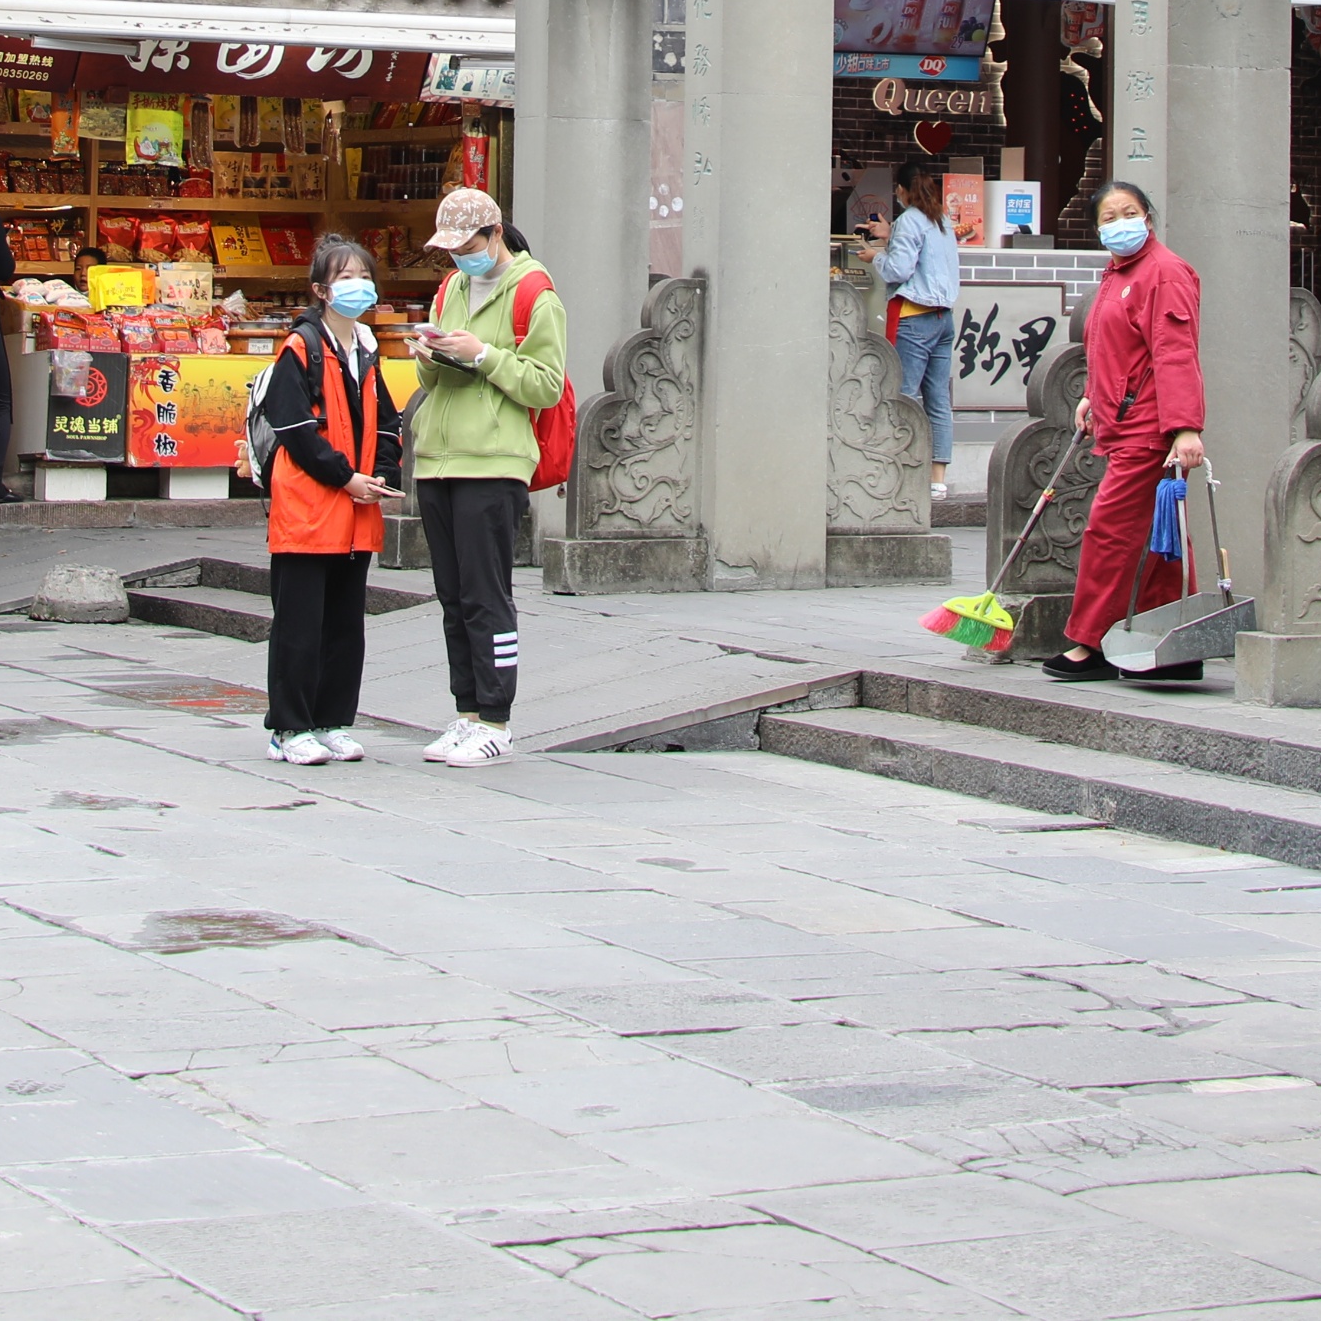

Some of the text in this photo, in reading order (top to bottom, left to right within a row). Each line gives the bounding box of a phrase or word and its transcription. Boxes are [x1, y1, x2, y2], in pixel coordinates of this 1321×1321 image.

[922, 58, 944, 72] DQ
[873, 78, 993, 116] Queen
[1006, 199, 1032, 209] 支付宝
[154, 368, 178, 456] 香脆椒
[53, 416, 119, 435] 灵魂当铺
